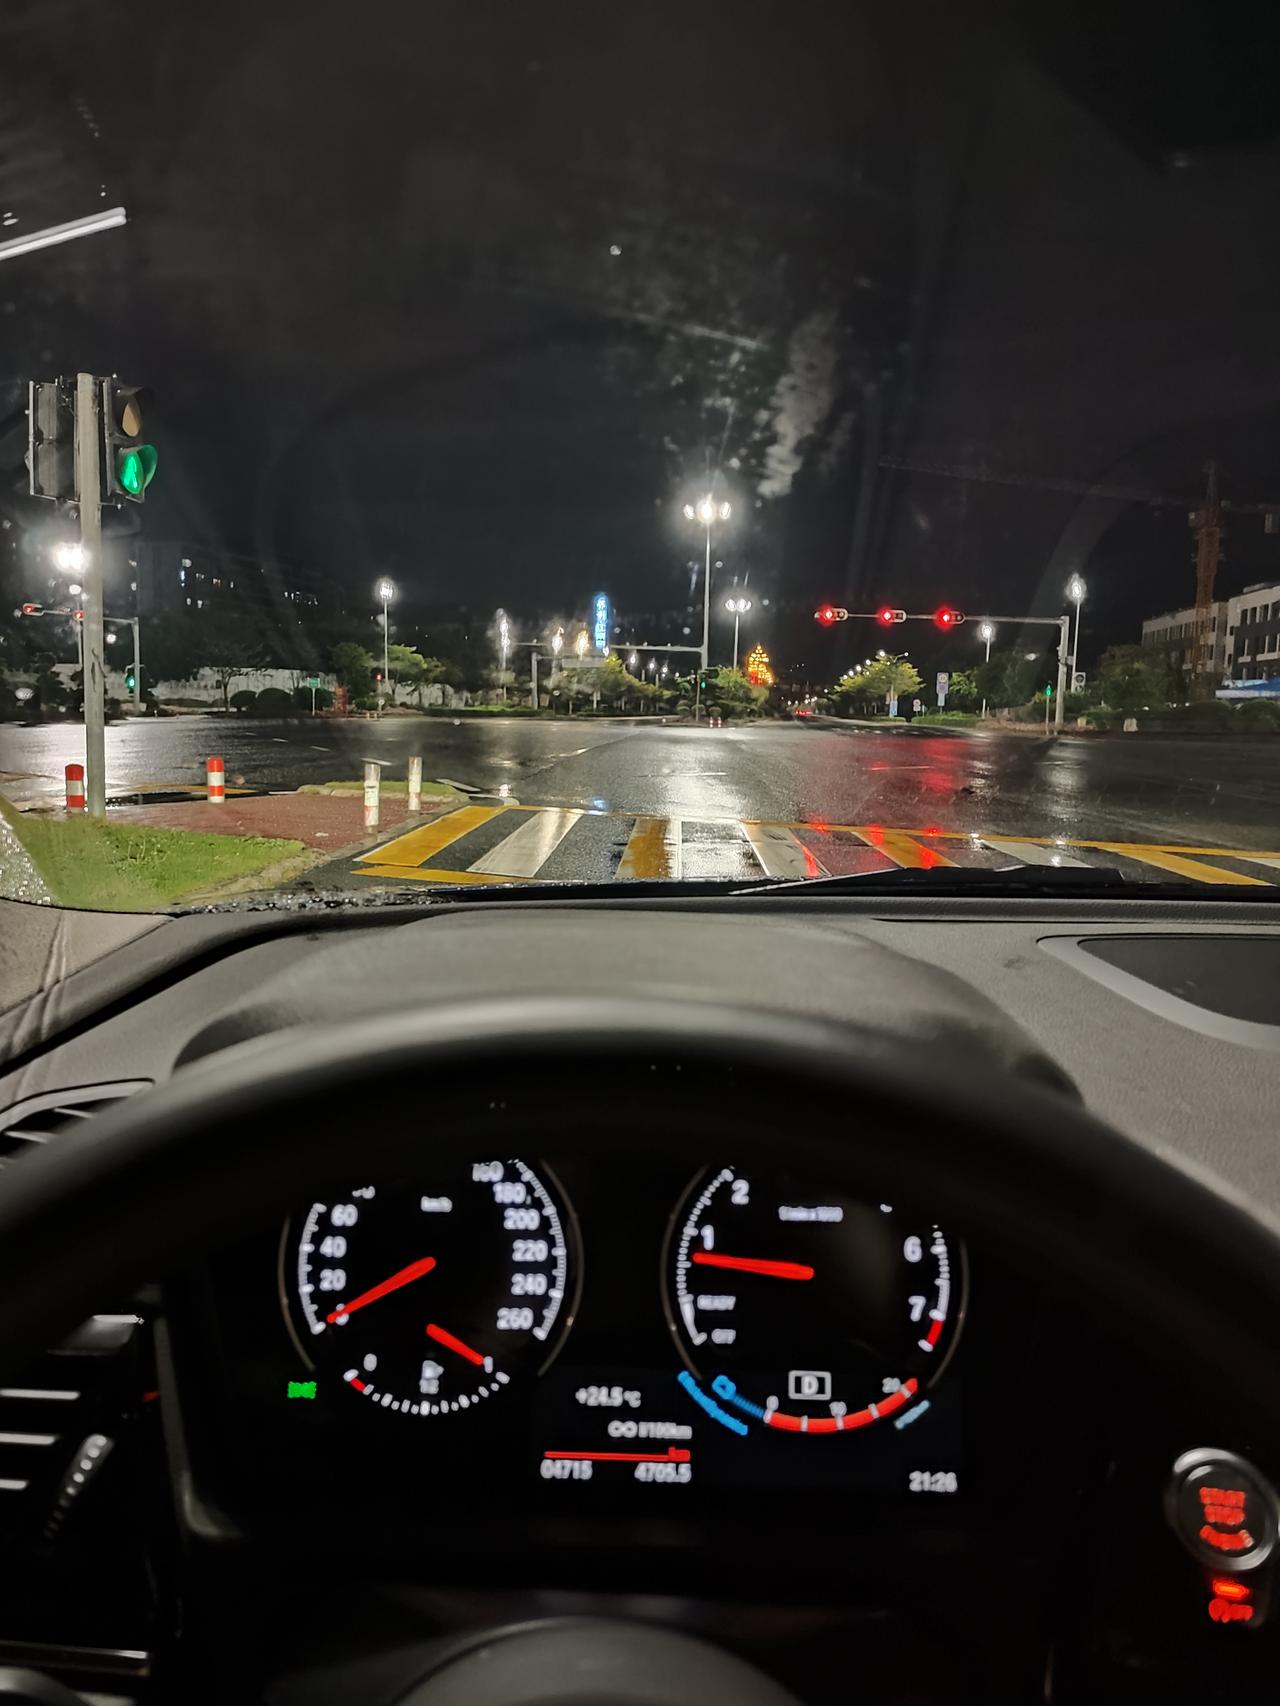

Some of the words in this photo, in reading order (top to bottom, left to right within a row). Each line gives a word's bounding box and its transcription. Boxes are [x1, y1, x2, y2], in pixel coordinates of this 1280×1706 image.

[493, 1181, 527, 1204] 180
[731, 1179, 749, 1204] 2
[331, 1204, 358, 1226] 60
[504, 1208, 540, 1230] 200
[320, 1236, 346, 1258] 40
[701, 1225, 714, 1250] 1
[512, 1239, 548, 1262] 220
[904, 1236, 922, 1262] 6
[320, 1269, 346, 1290] 20
[511, 1273, 547, 1295] 240
[497, 1307, 533, 1329] 260
[909, 1296, 926, 1321] 7
